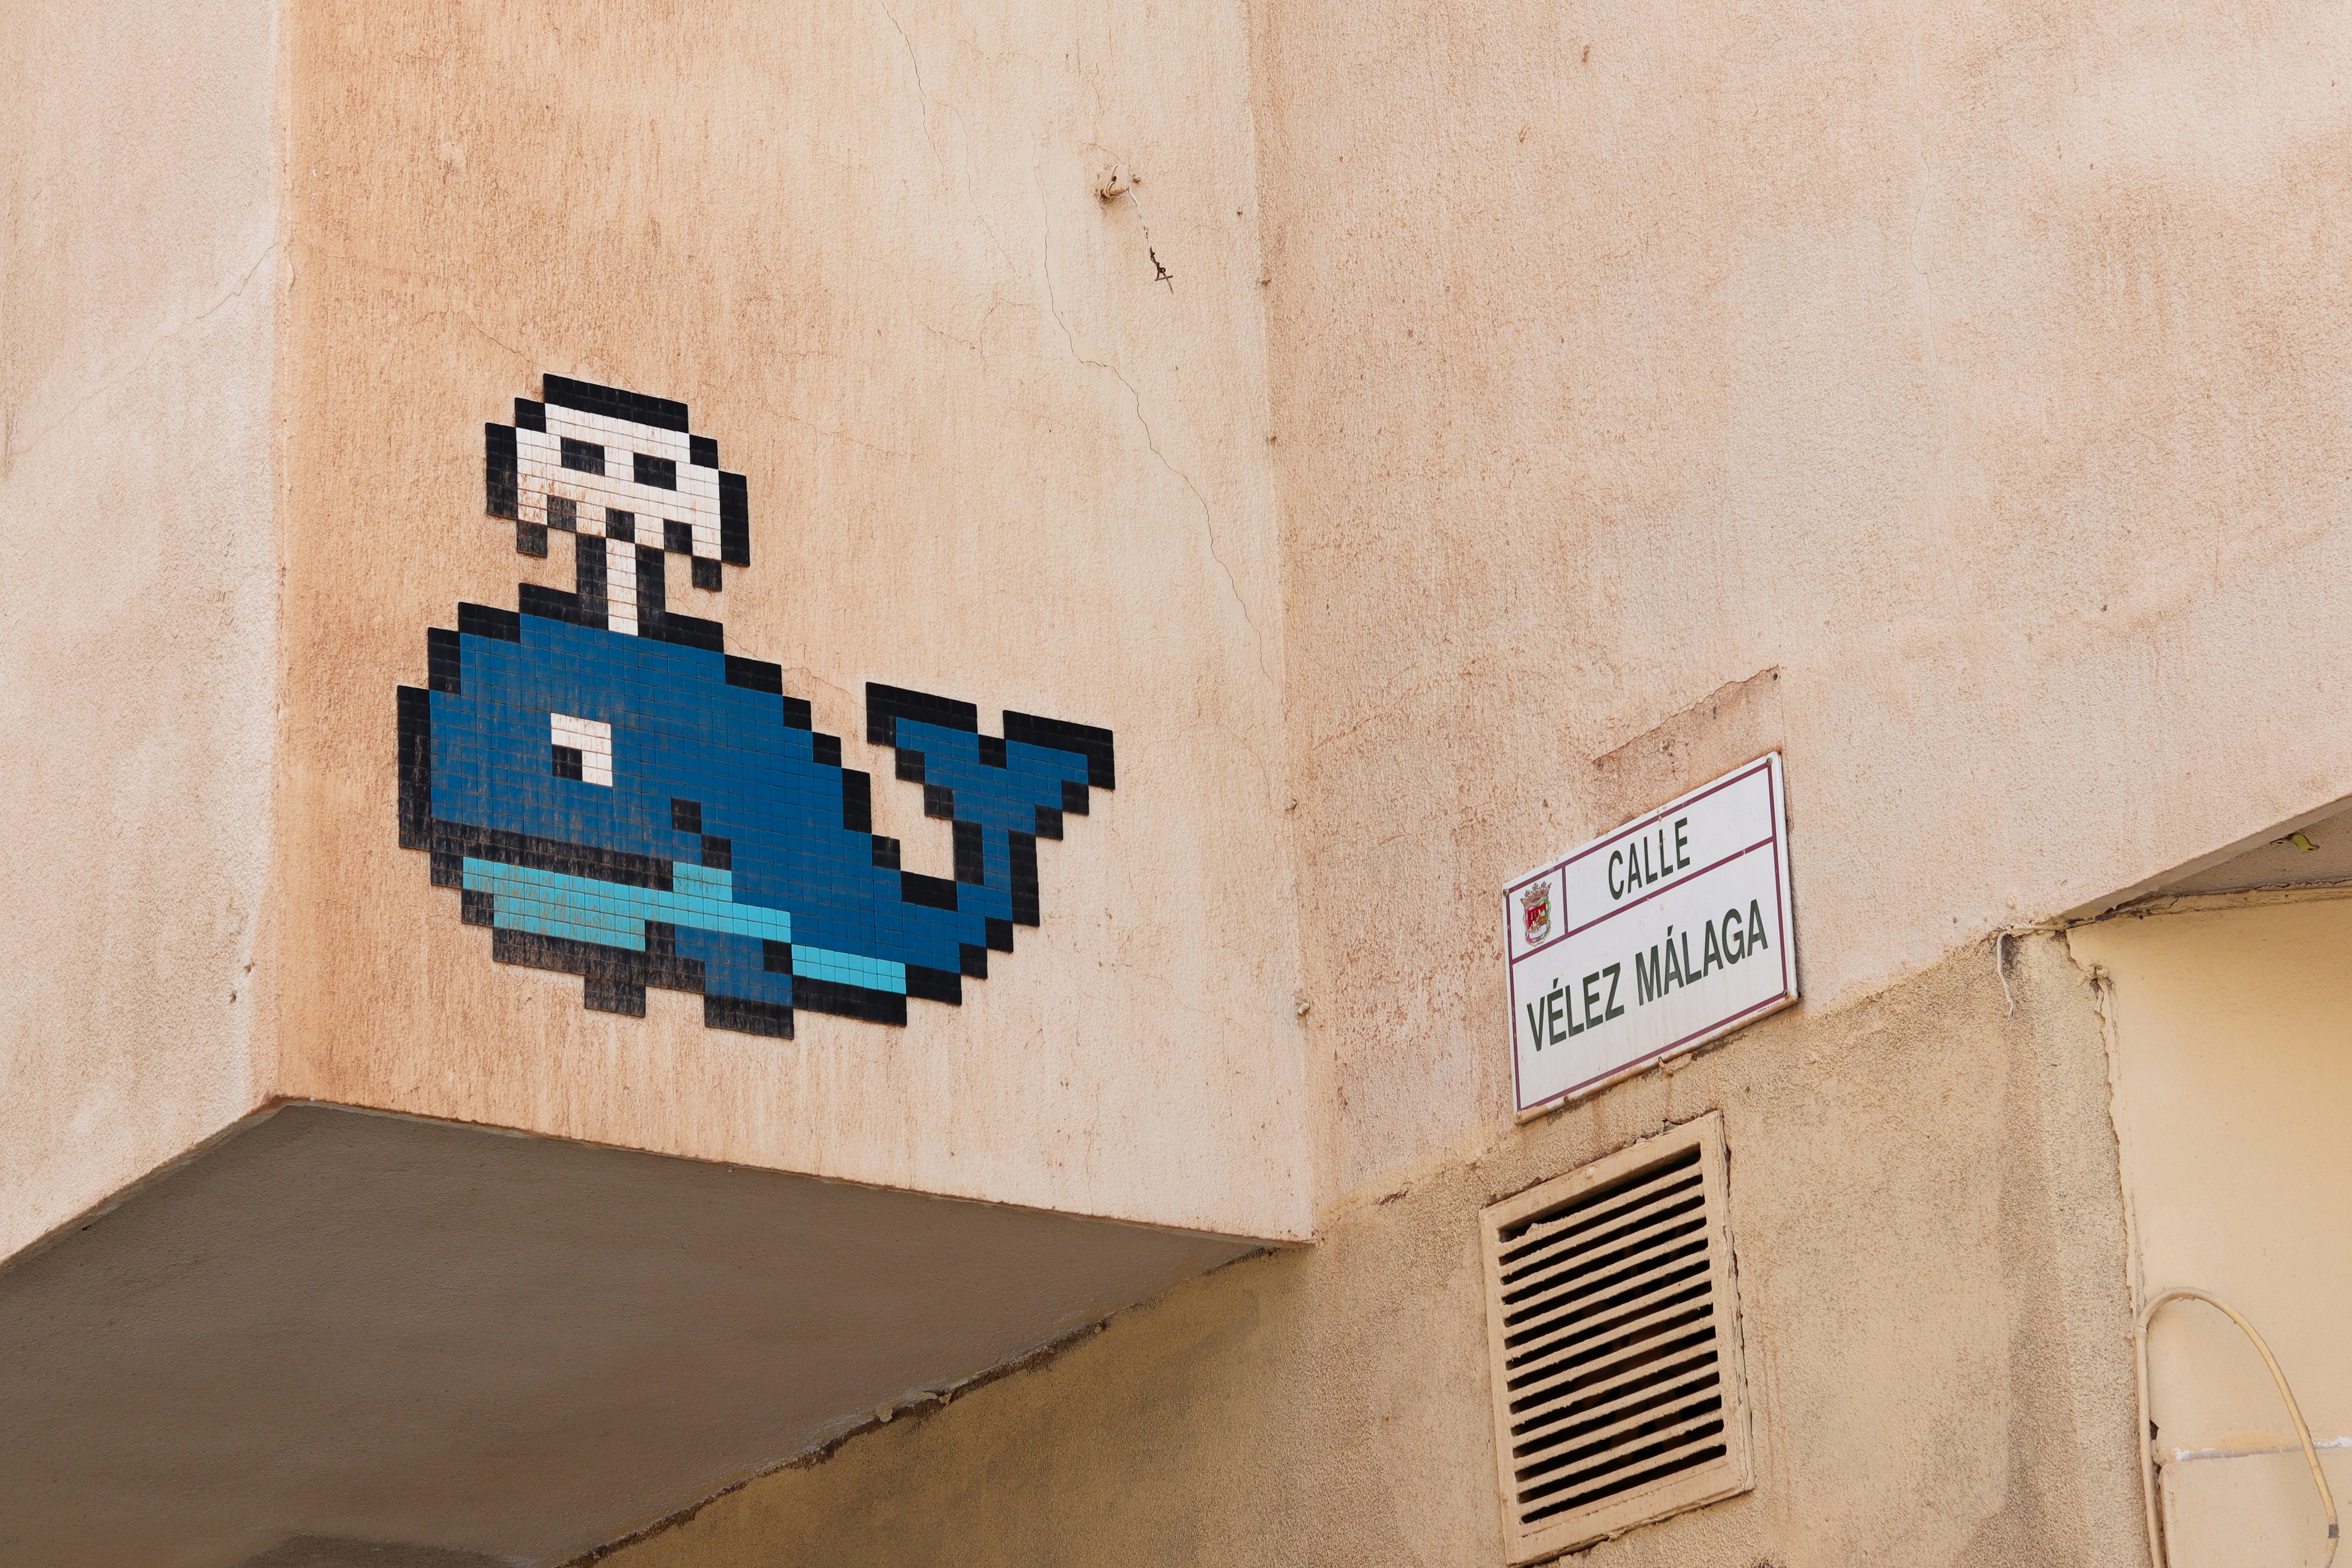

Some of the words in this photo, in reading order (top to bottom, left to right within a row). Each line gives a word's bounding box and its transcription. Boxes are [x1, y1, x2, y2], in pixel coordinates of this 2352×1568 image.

[1608, 817, 1690, 900] CALLE
[1527, 962, 1625, 1051] VÉLEZ
[1635, 899, 1768, 1006] MÁLAGA
